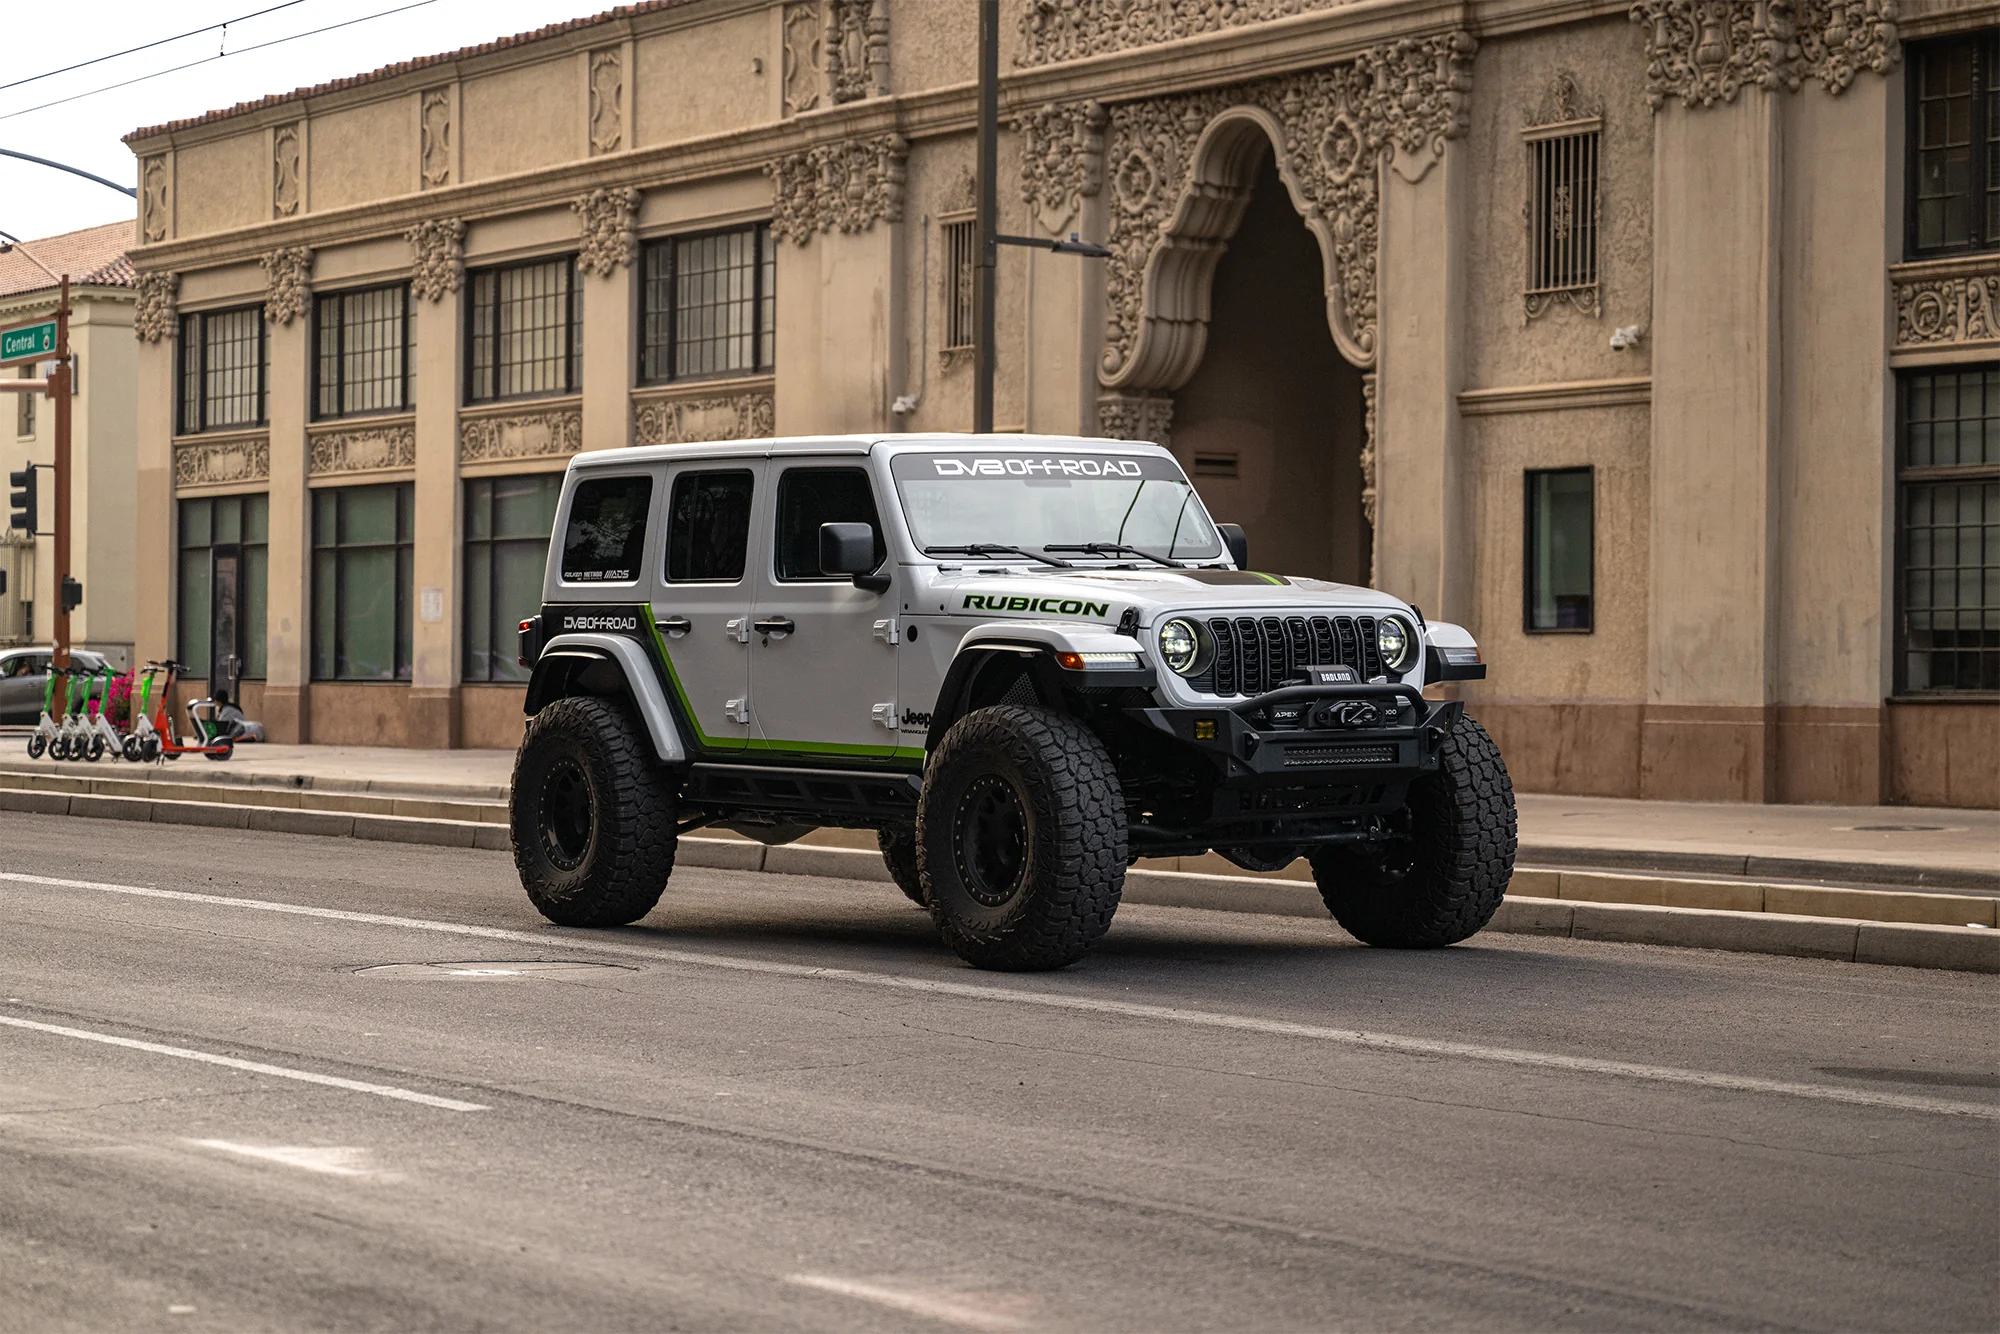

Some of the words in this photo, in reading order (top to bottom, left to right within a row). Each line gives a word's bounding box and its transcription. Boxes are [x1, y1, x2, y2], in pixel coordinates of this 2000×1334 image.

[6, 333, 35, 353] Central
[962, 595, 1110, 617] RUBICON
[1321, 672, 1351, 682] BADLAND
[901, 708, 931, 728] Jeep
